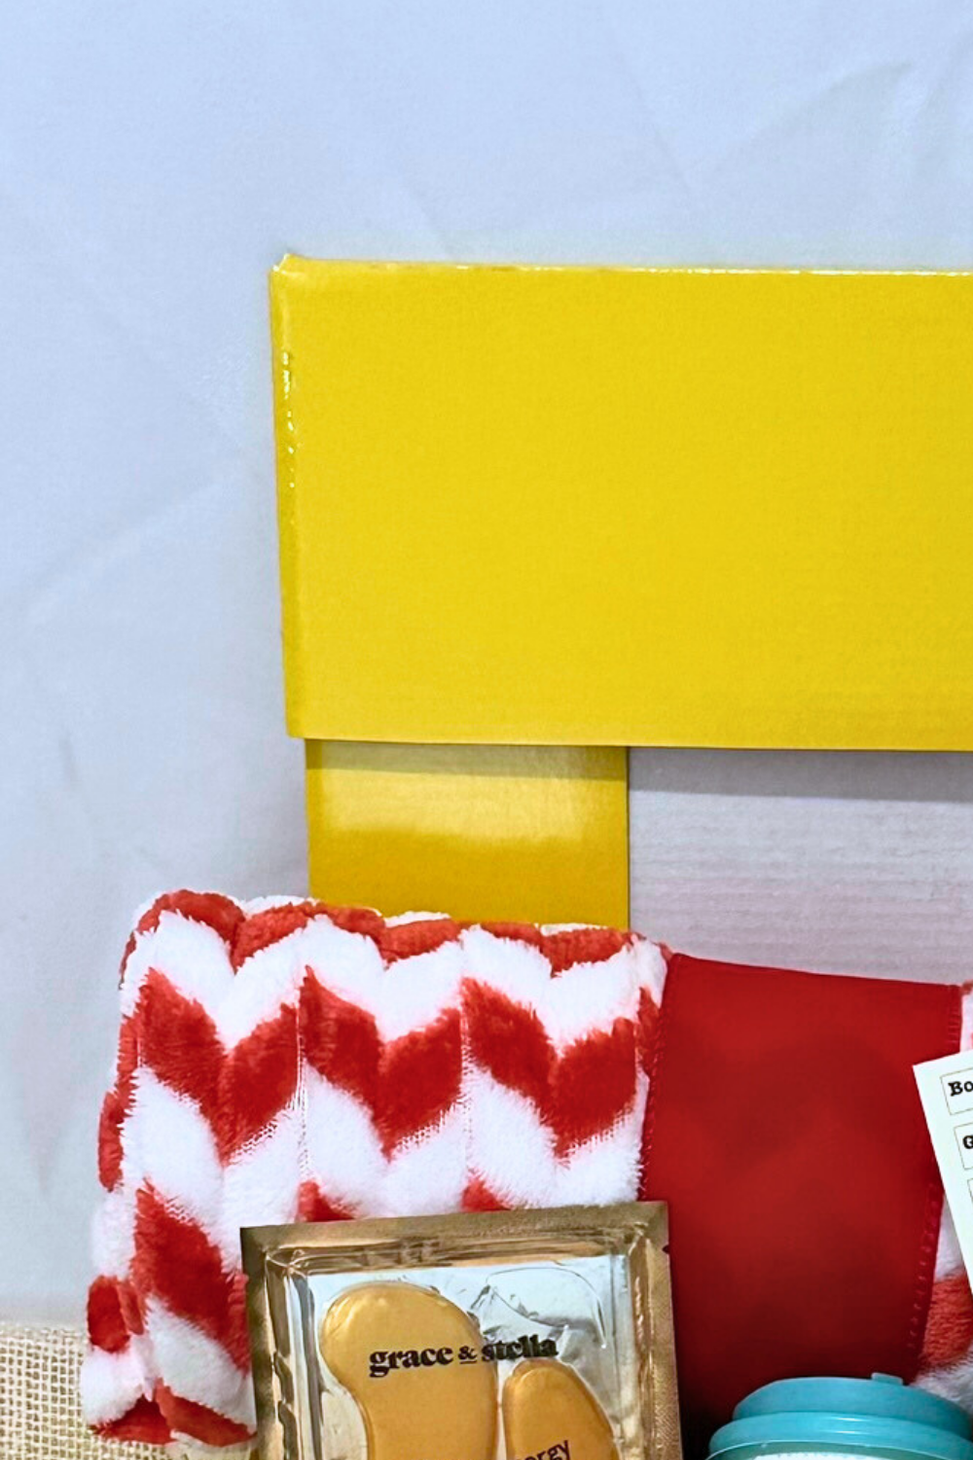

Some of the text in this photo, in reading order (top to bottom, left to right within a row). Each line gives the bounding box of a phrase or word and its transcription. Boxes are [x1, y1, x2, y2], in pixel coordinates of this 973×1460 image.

[368, 1334, 559, 1378] grace & stella
